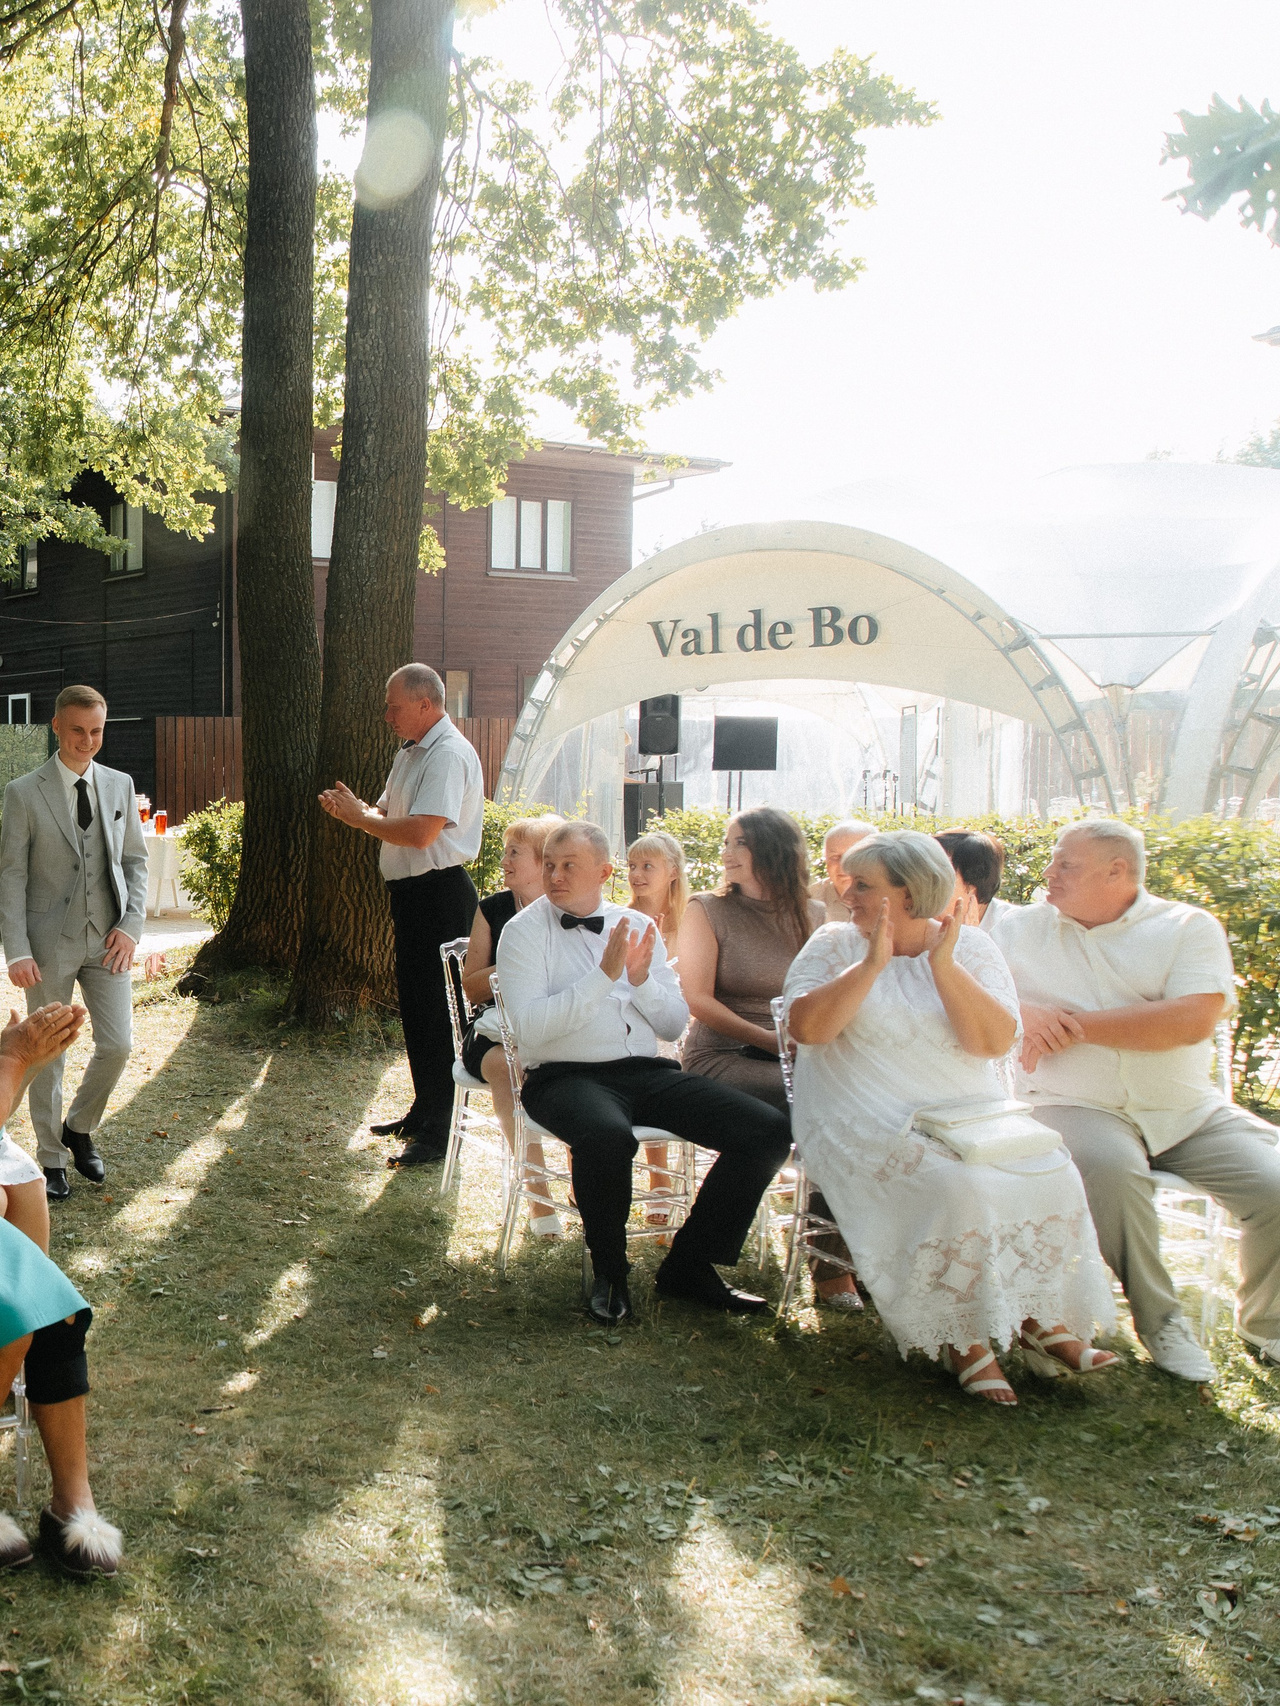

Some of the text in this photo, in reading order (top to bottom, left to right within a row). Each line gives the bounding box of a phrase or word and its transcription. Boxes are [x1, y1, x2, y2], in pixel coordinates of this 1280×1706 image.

[647, 605, 880, 657] Val de Bo
